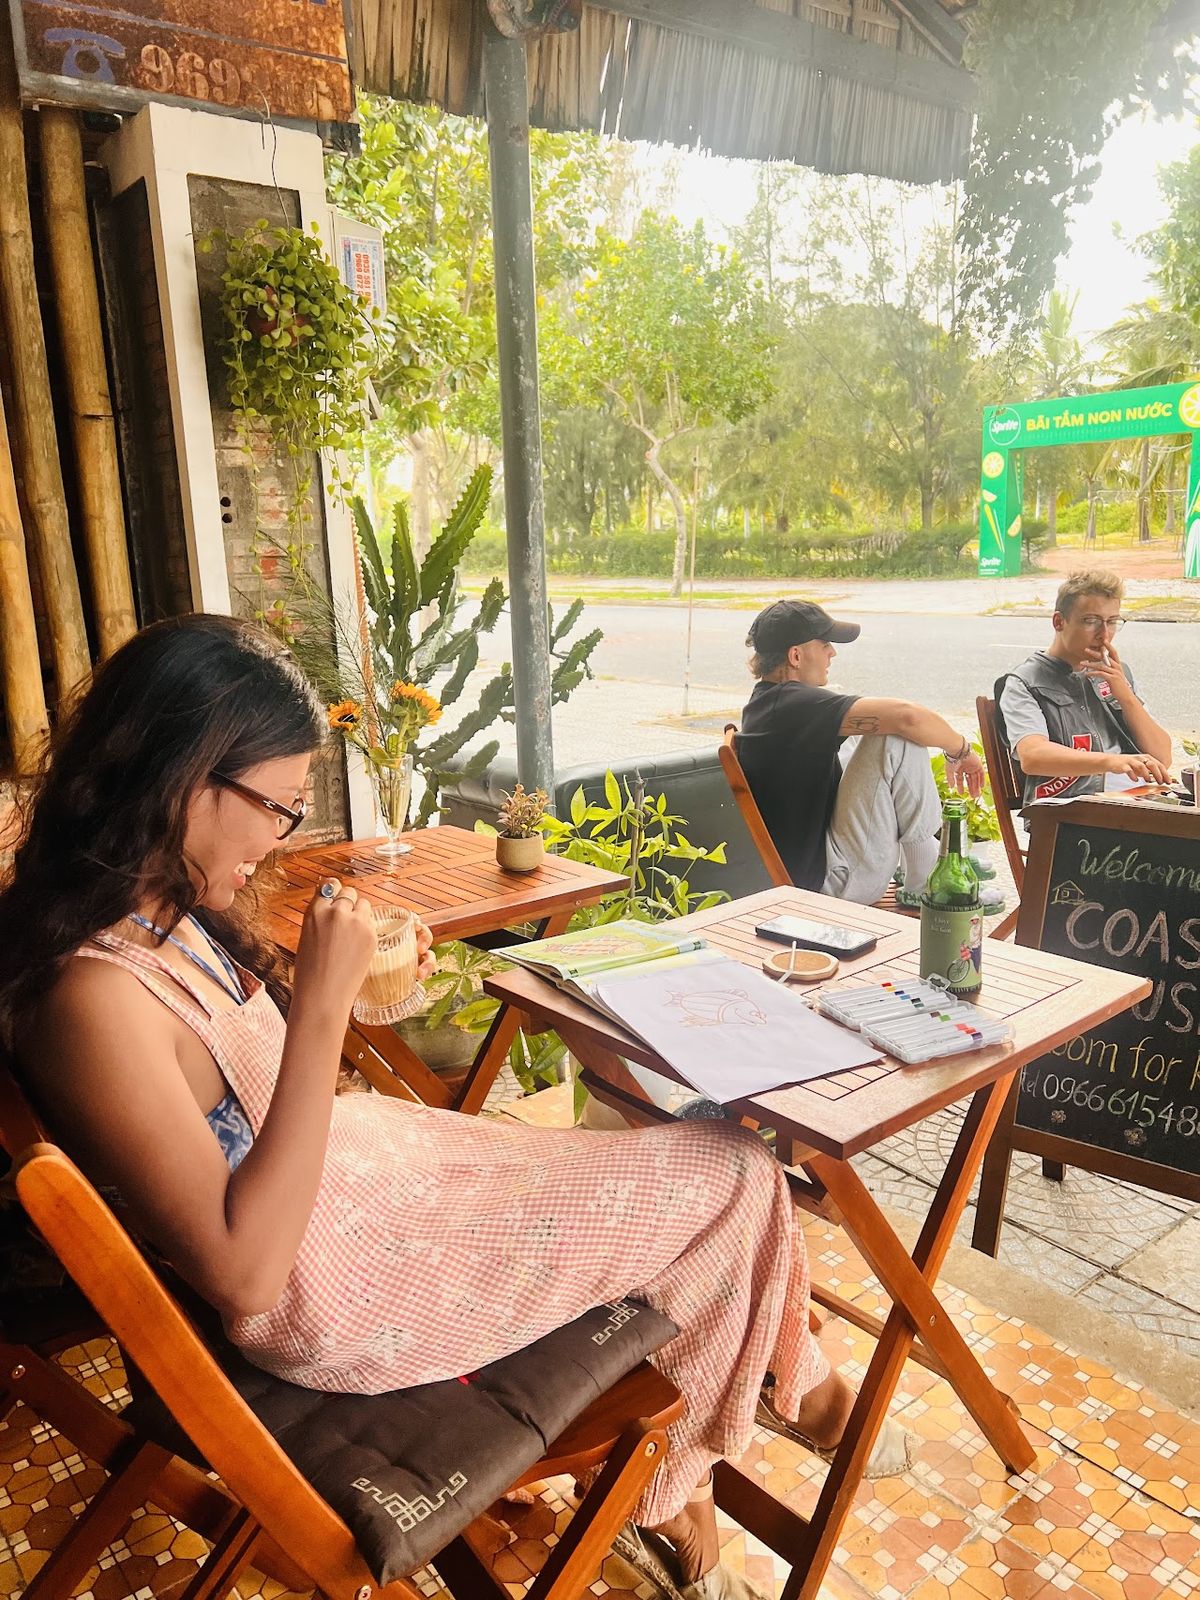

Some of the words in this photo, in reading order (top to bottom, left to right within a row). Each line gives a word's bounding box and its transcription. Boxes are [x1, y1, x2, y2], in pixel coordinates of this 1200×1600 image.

[1087, 409, 1122, 425] NON
[991, 419, 1018, 434] Sprite
[980, 556, 1002, 568] Sprite
[1129, 1036, 1183, 1085] for
[1021, 1067, 1040, 1098] tel
[1043, 1073, 1200, 1137] 096661548
